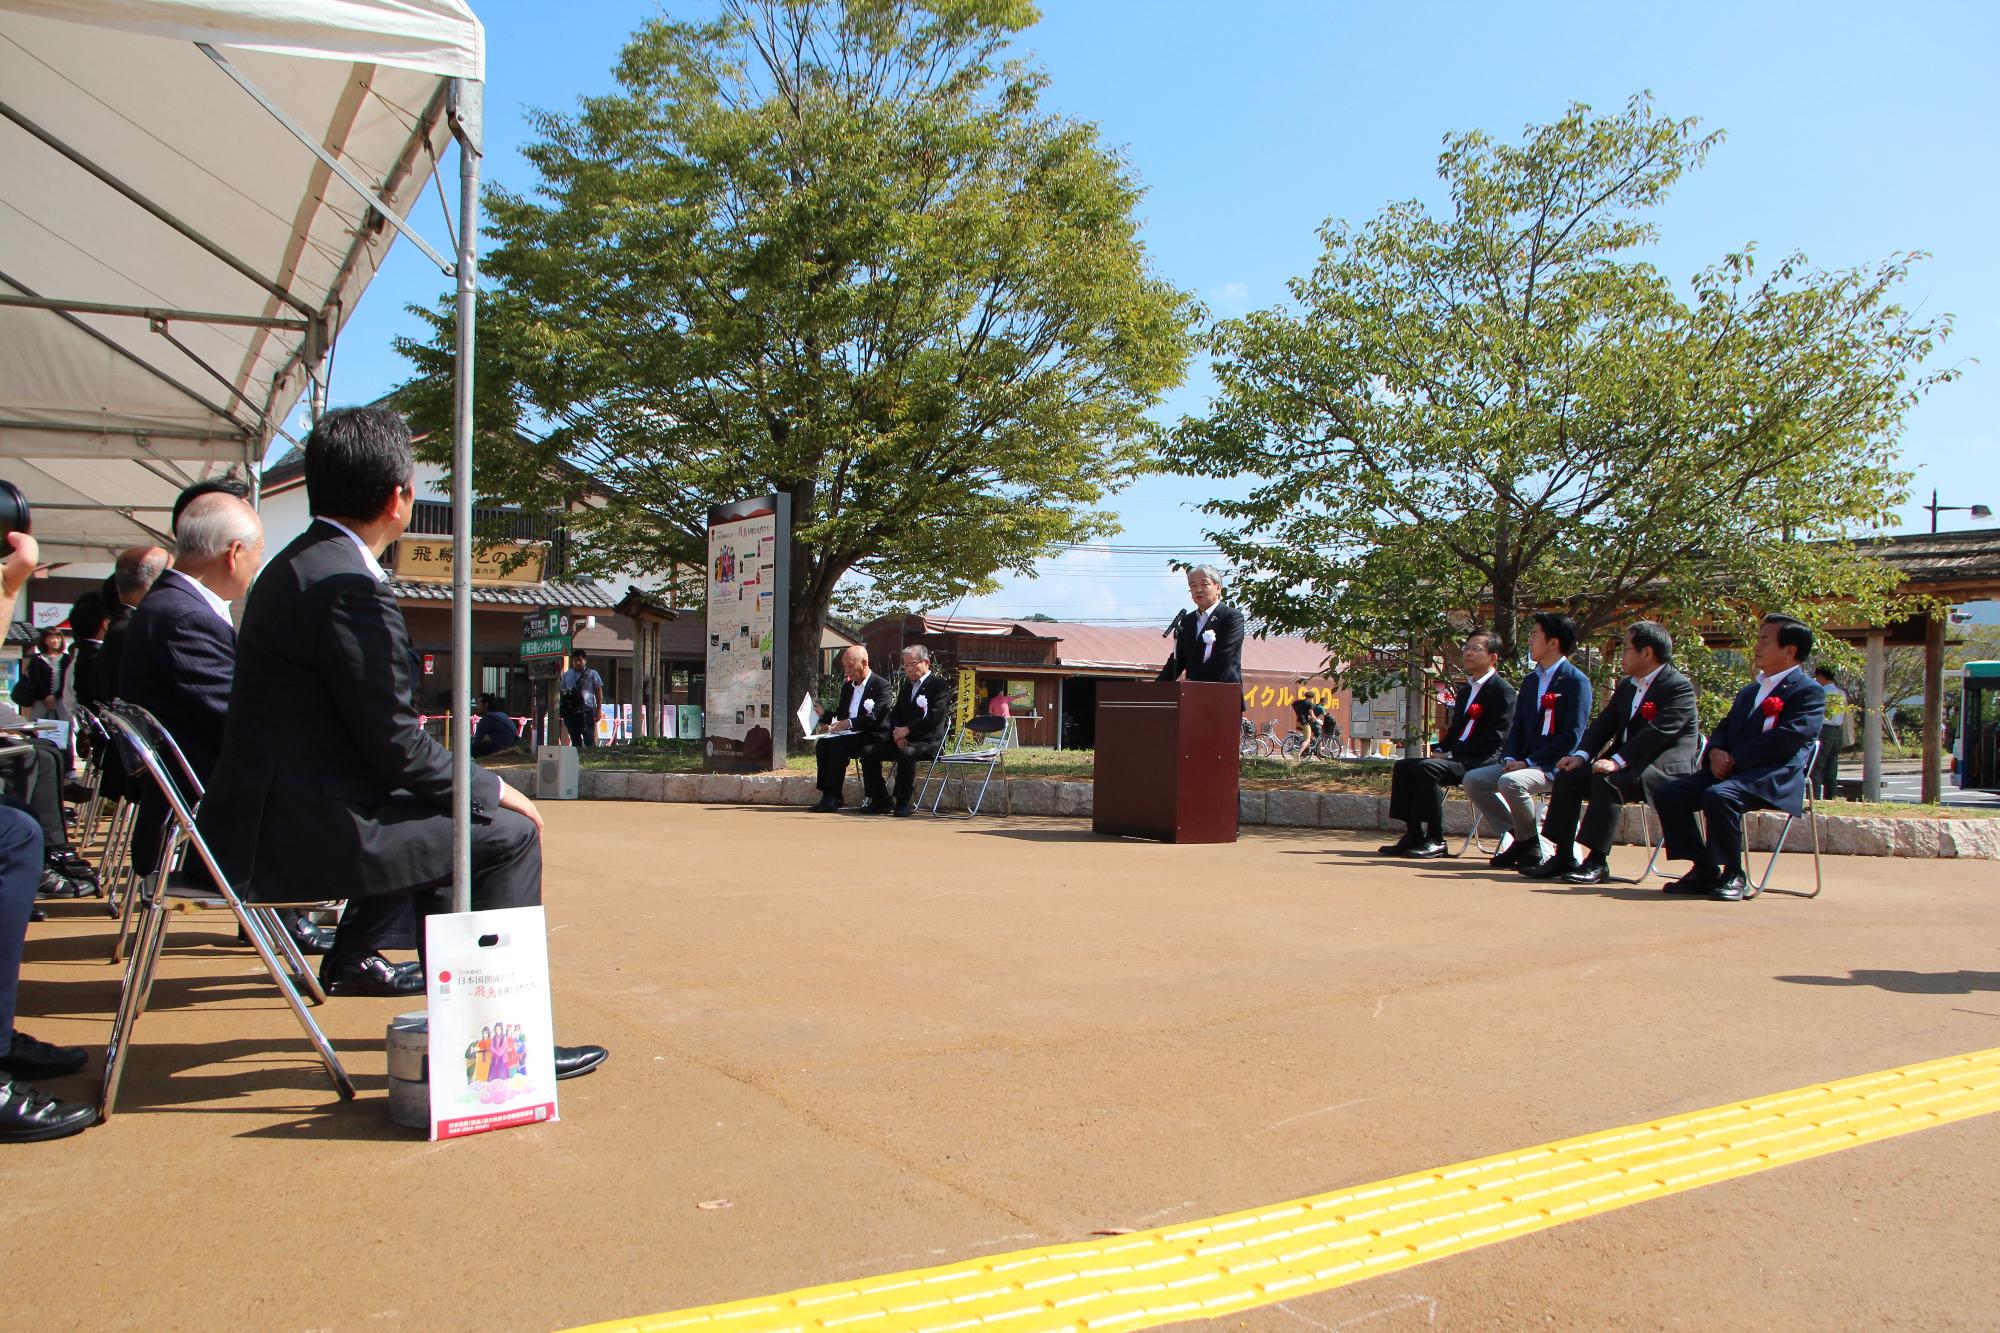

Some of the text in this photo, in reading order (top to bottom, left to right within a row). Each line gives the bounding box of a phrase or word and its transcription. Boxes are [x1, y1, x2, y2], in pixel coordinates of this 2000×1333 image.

[412, 546, 529, 567] 飛鳥との
[550, 614, 558, 633] P
